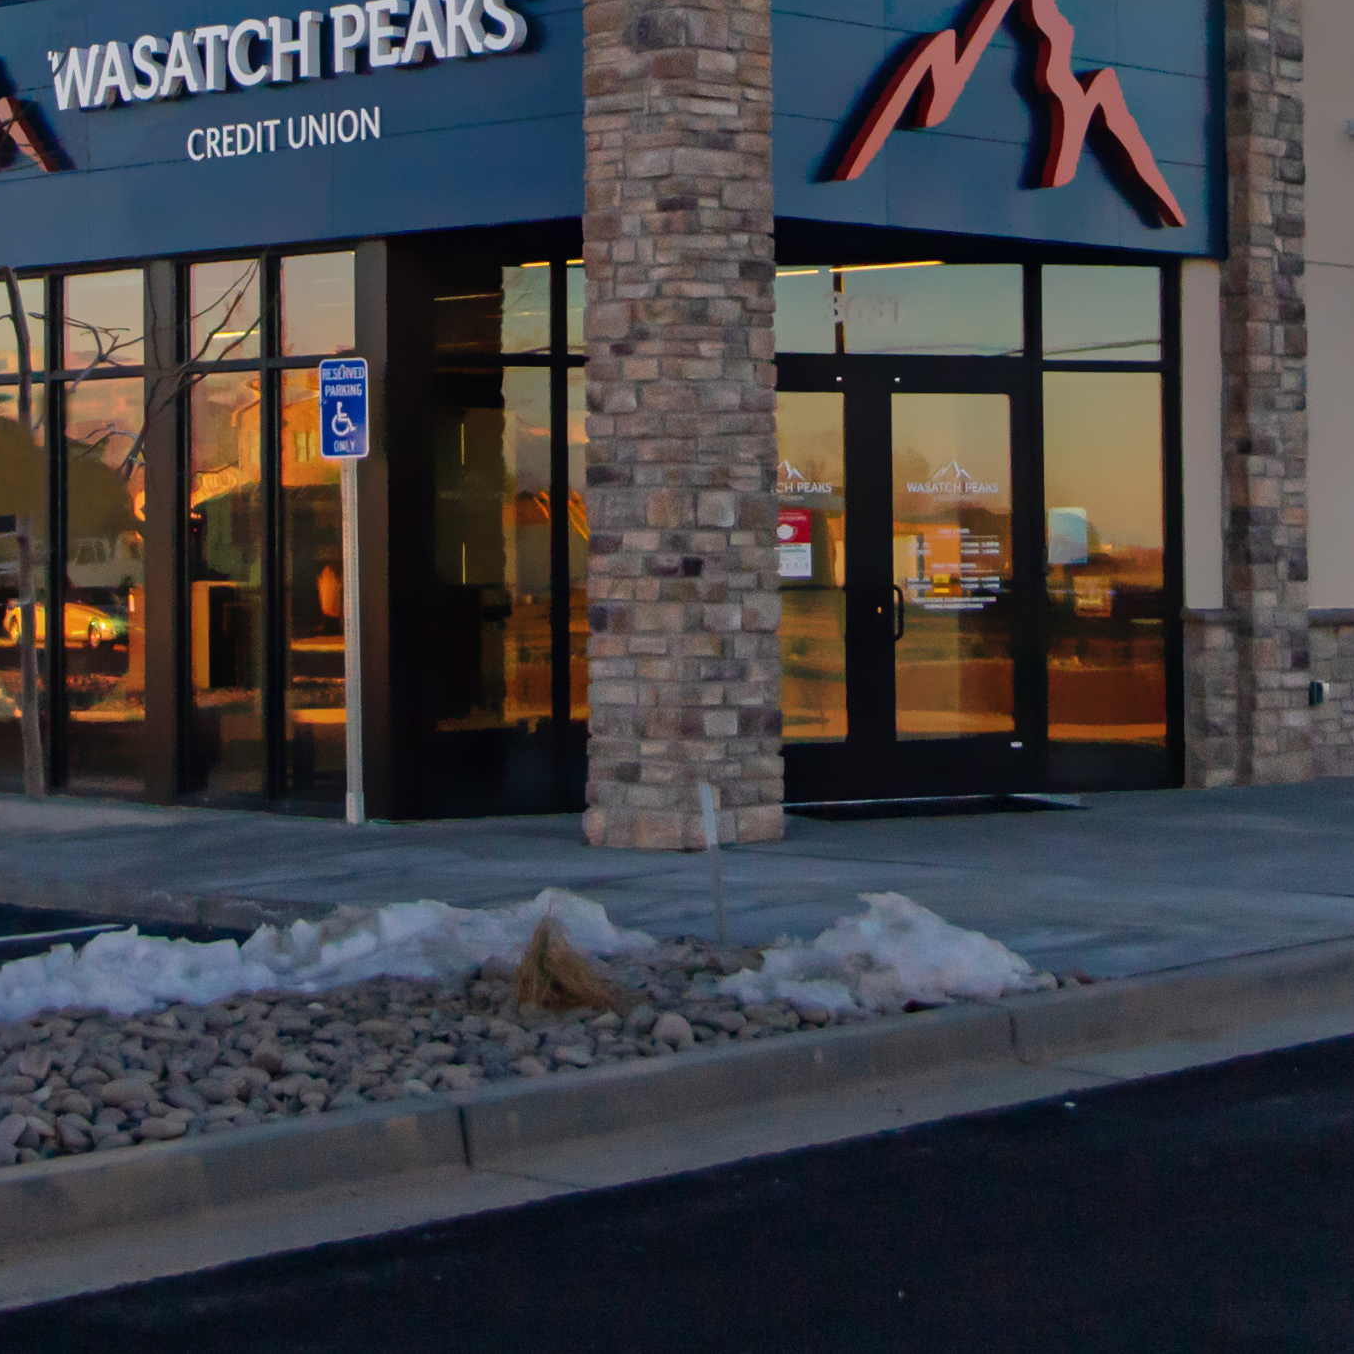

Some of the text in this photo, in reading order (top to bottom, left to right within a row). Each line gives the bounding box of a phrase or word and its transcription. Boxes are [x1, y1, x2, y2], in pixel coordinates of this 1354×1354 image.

[48, 10, 324, 110] WASATCH
[187, 106, 381, 162] CREDIT UNION
[321, 366, 365, 381] RESERVED
[324, 383, 363, 397] PARKING
[333, 439, 356, 453] ONLY
[797, 481, 832, 493] PEAKS
[906, 481, 999, 494] WASATCH PEAKS
